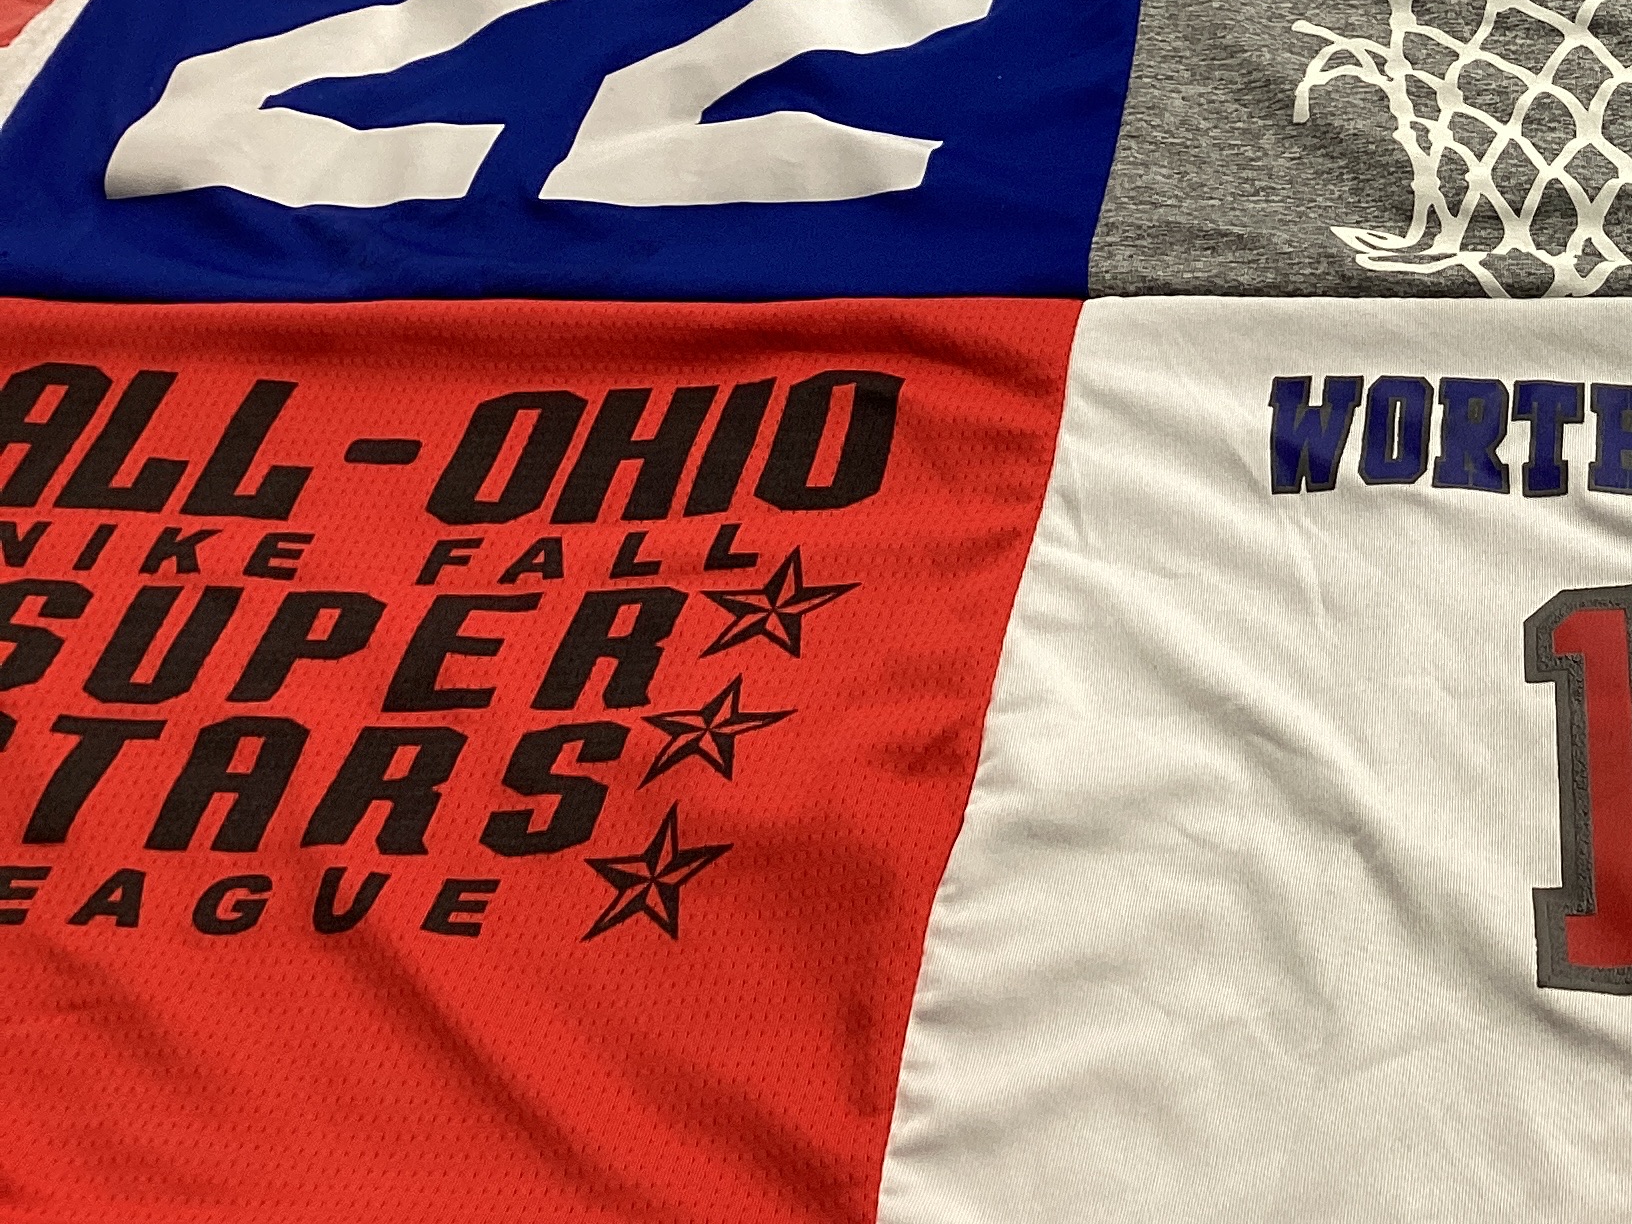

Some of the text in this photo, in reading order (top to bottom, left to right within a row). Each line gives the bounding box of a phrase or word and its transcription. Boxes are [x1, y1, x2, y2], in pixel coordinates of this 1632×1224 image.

[0, 521, 760, 587] NIKE FALL
[0, 578, 690, 714] SUPER
[0, 710, 630, 858] TARS
